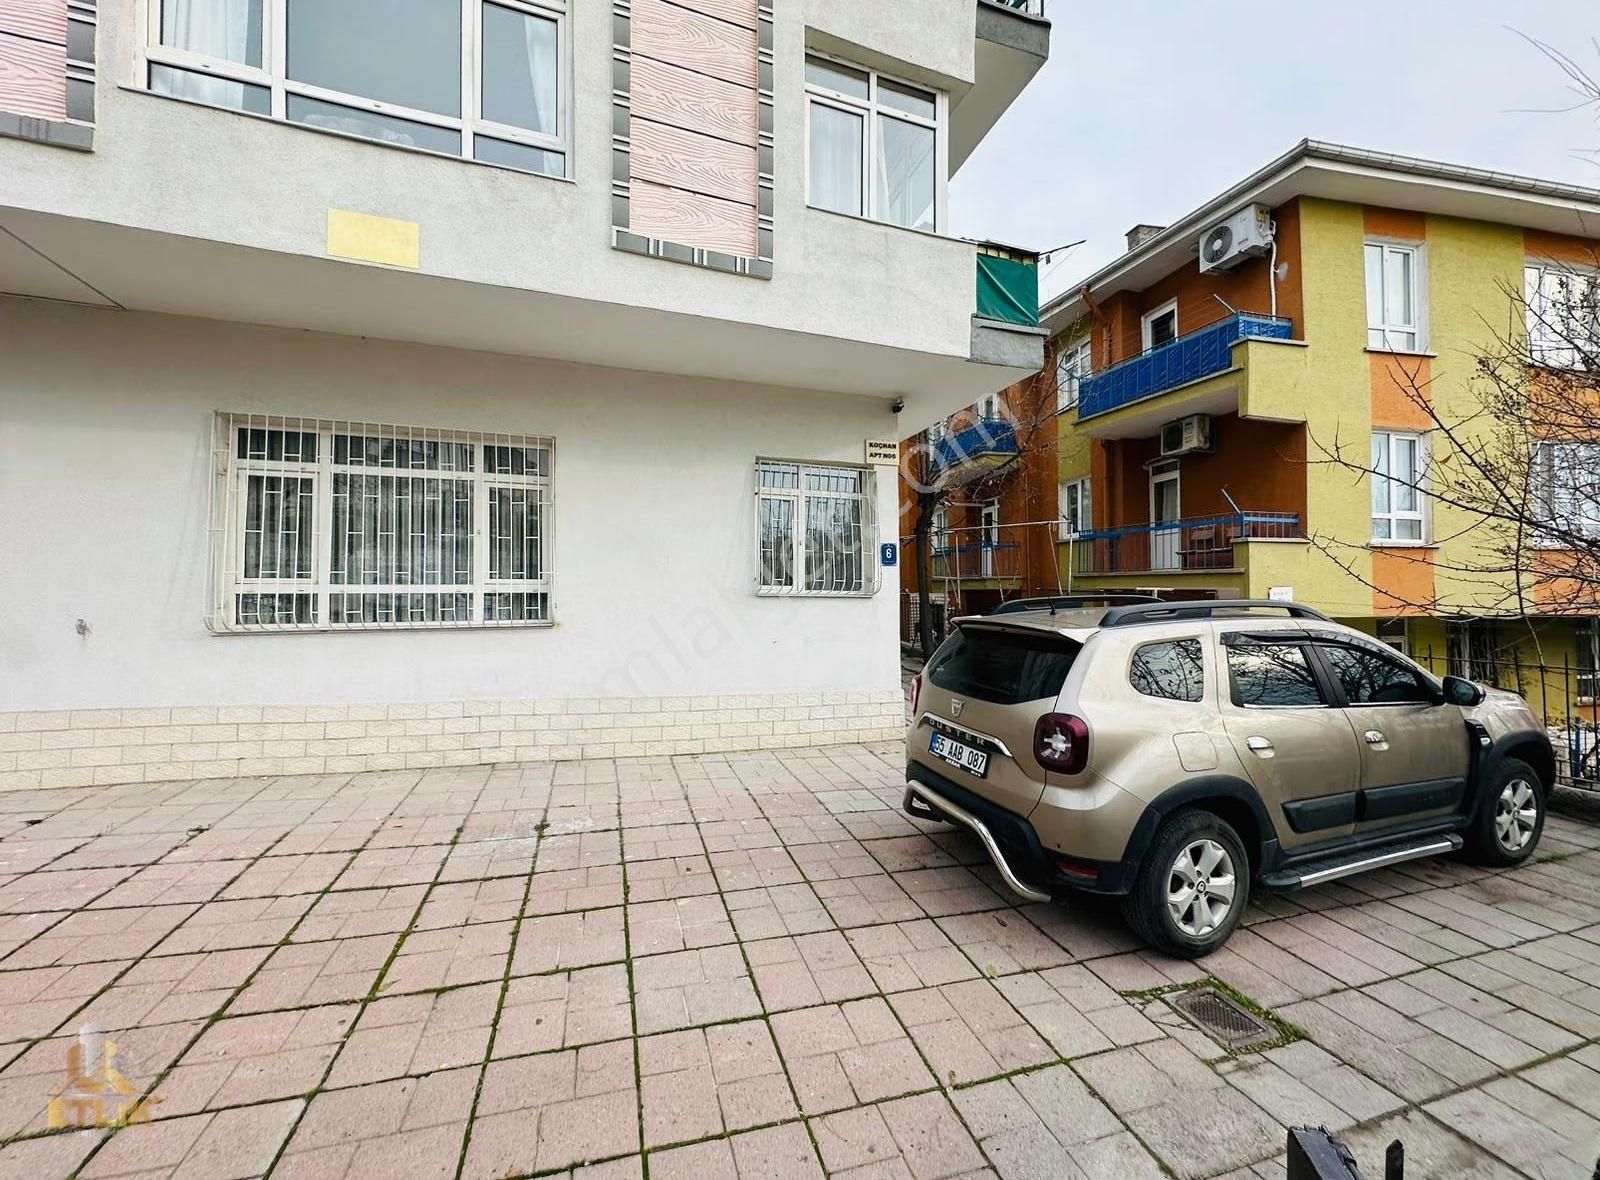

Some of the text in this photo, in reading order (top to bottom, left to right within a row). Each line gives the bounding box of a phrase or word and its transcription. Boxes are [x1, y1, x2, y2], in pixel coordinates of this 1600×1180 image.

[886, 548, 892, 559] 6
[929, 719, 985, 746] DUSTER
[947, 742, 964, 761] AAB
[967, 750, 986, 771] 087
